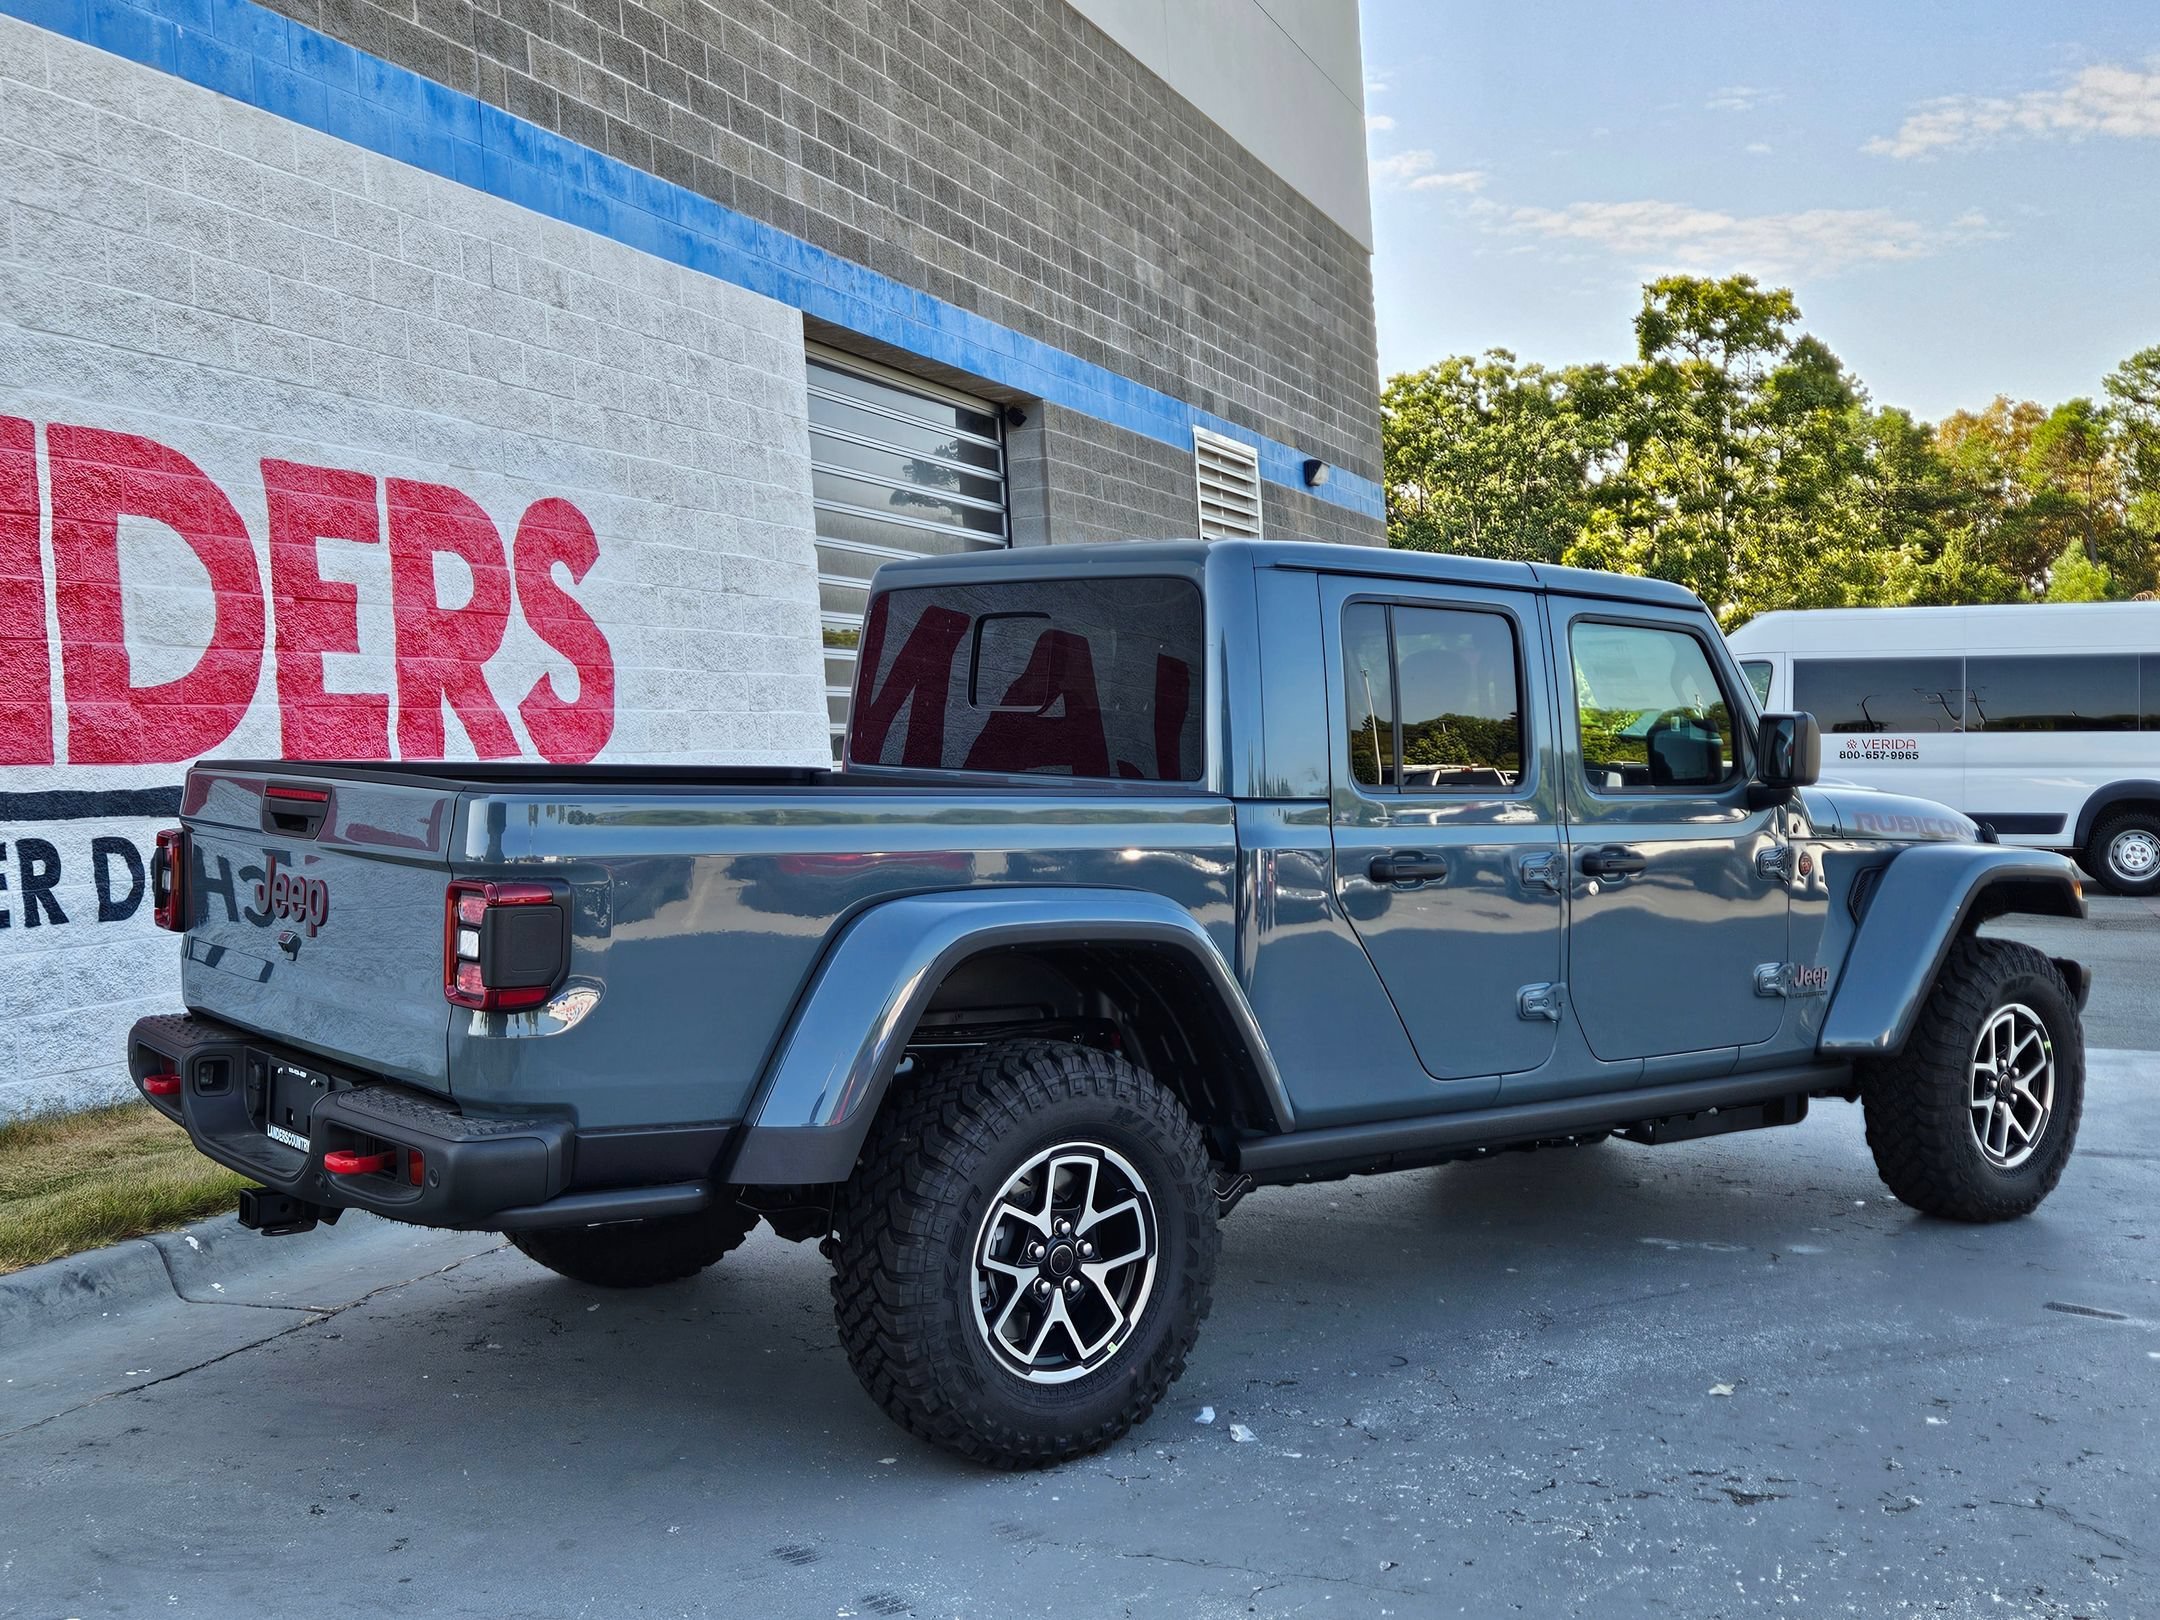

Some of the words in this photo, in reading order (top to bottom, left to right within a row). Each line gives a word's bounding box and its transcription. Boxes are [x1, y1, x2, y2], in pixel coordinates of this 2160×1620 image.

[0, 415, 615, 764] DERS
[1839, 750, 1919, 760] 800-657-9965
[1861, 738, 1917, 750] VERIDA
[1853, 812, 1976, 839] RUBICON
[92, 836, 157, 926] D
[254, 854, 329, 938] Jeep
[1793, 964, 1829, 988] Jeep
